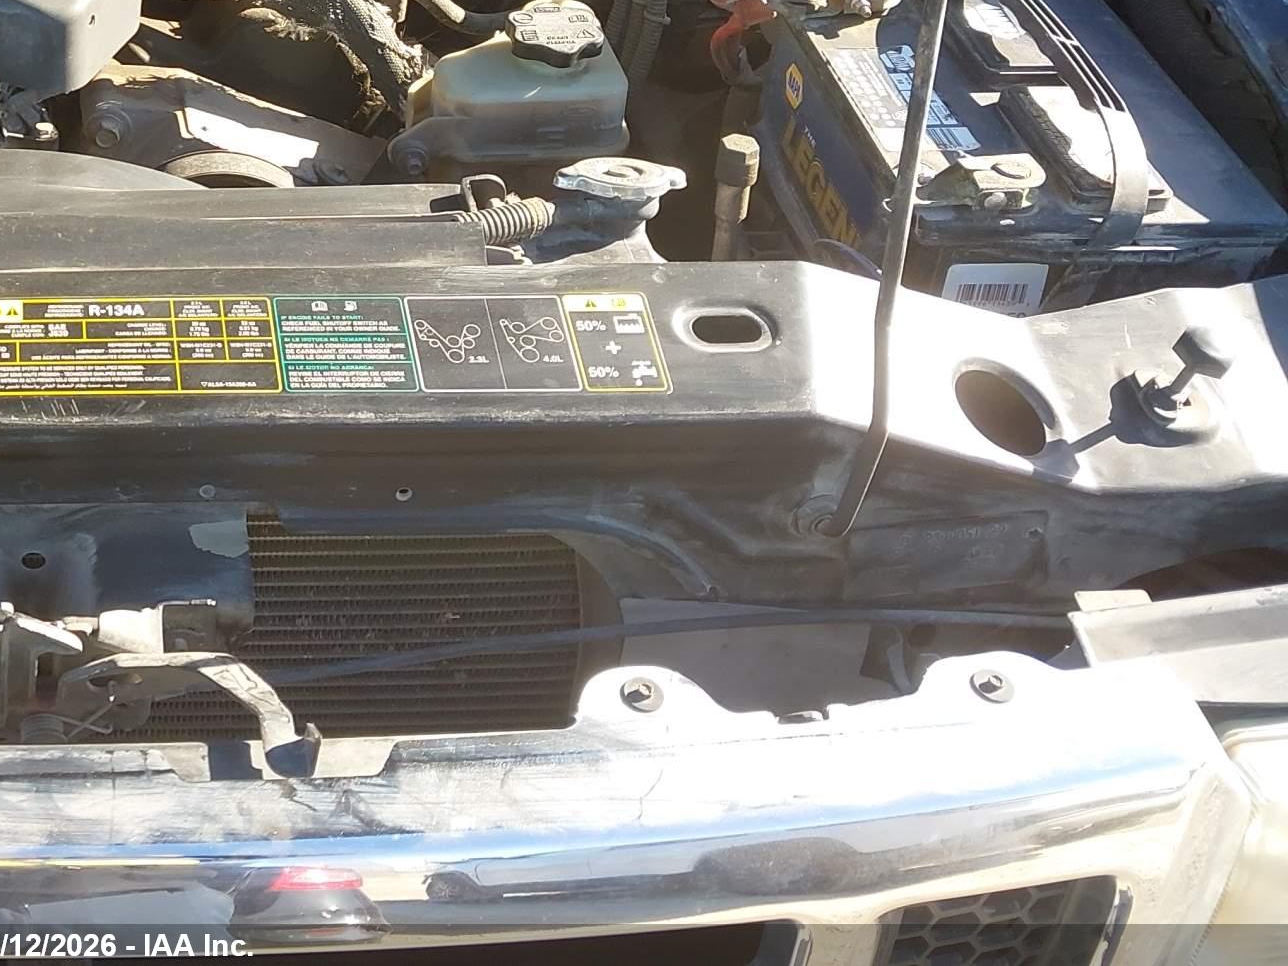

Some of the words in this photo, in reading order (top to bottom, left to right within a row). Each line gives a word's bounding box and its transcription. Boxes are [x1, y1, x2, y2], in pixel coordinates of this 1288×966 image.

[788, 72, 801, 101] NAPA
[88, 304, 145, 316] R-134A
[575, 320, 607, 332] 50%
[542, 355, 564, 363] 4.0L
[588, 367, 620, 379] 50%
